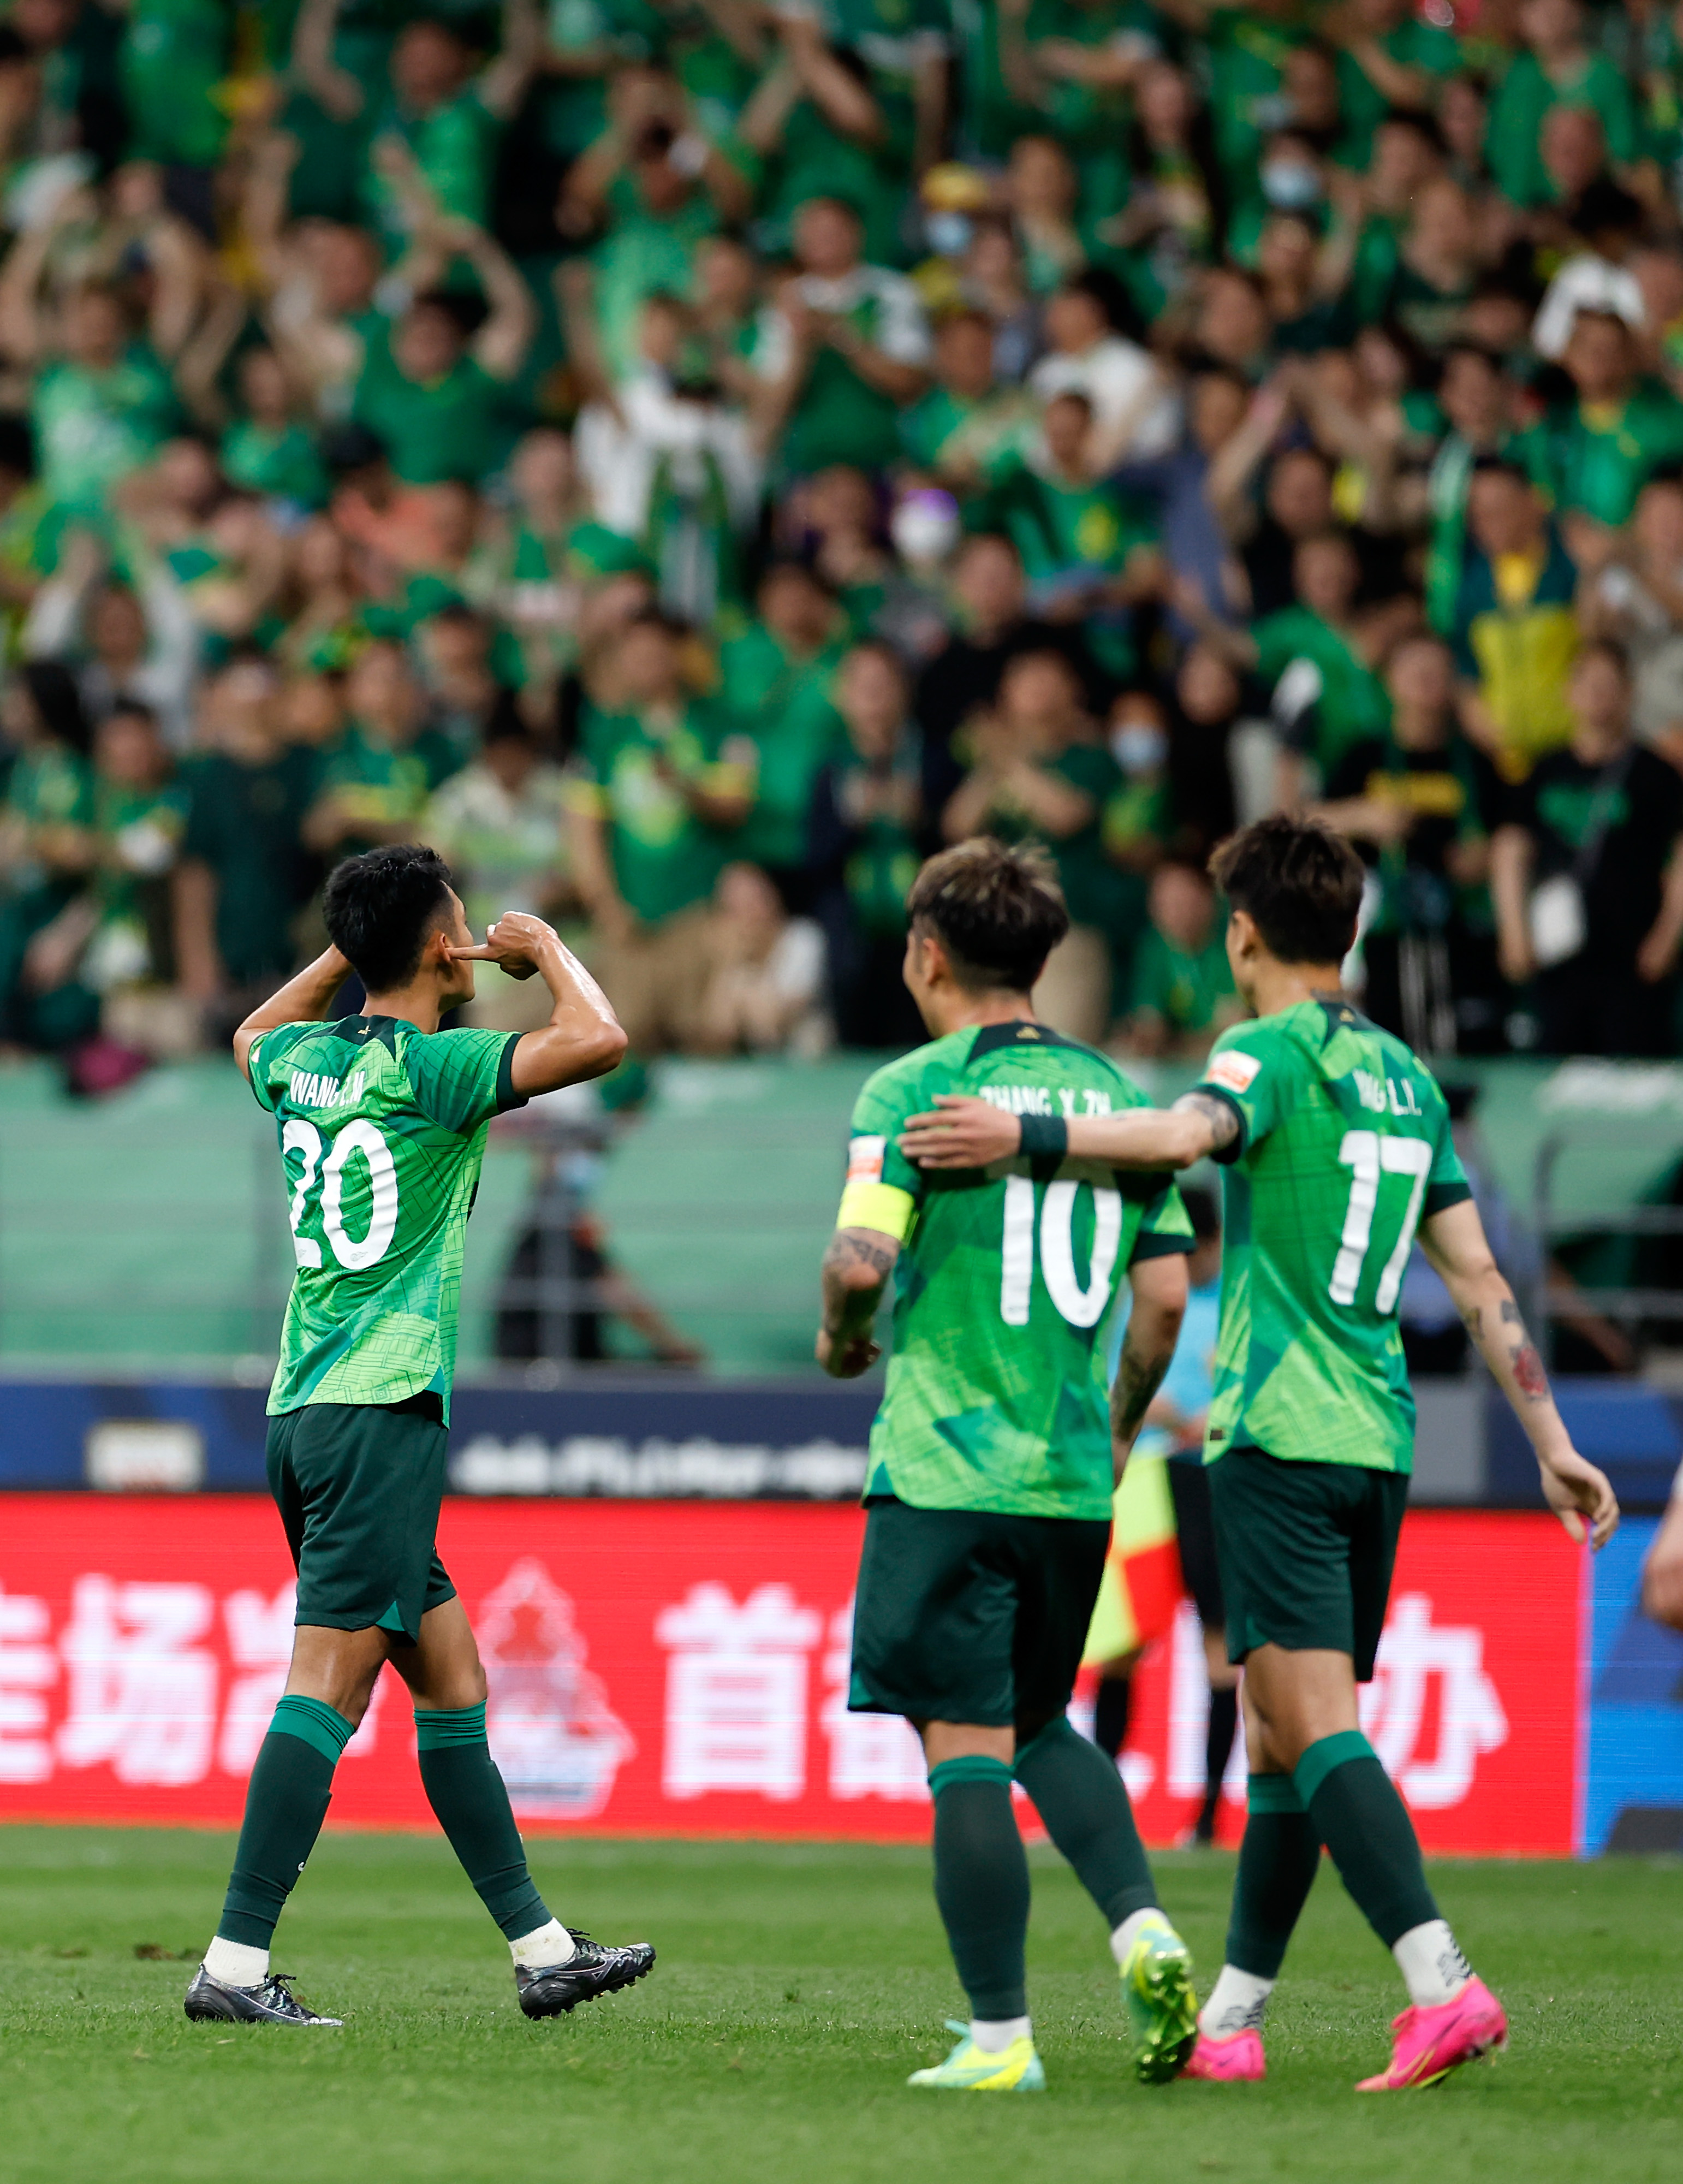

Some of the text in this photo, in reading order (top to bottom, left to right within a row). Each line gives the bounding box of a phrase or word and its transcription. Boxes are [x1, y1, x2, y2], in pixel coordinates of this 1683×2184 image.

[290, 1071, 340, 1108] WANG
[282, 1118, 399, 1270] 20
[989, 1156, 1122, 1328] 10
[1328, 1130, 1432, 1314] 17
